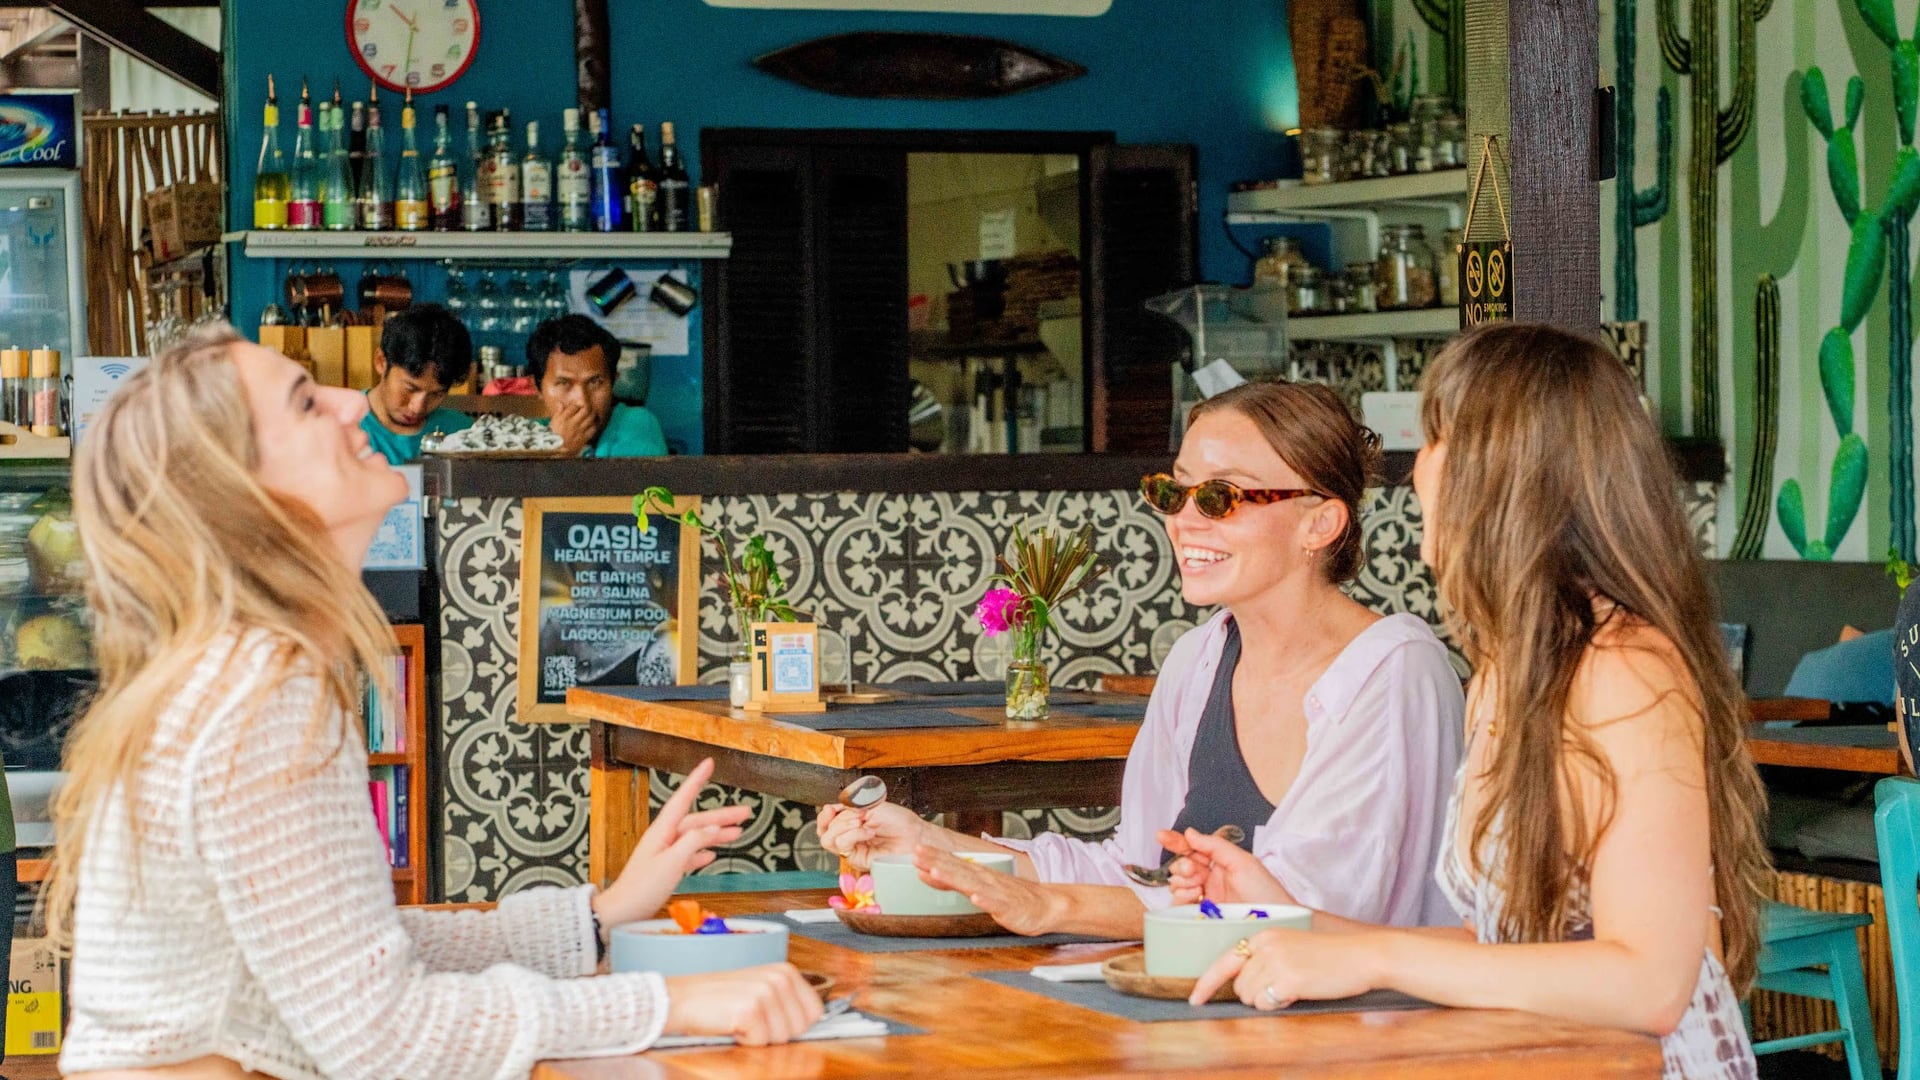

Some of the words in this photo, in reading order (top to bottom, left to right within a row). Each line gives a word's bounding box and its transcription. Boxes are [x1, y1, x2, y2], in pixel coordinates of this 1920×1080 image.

[363, 42, 377, 57] 8
[381, 64, 397, 79] 7
[431, 63, 446, 78] 5
[20, 139, 66, 162] Cool
[1465, 303, 1482, 327] NO
[567, 524, 659, 550] OASIS
[554, 548, 611, 563] HEALTH
[613, 550, 671, 564] TEMPLE
[575, 570, 598, 583] ICE
[600, 570, 647, 584] BATHS
[570, 586, 599, 598] DRY
[601, 586, 651, 600] SAUNA
[546, 607, 632, 621] MAGNESIUM
[634, 608, 672, 622] POOL
[560, 628, 618, 641] LAGOON
[620, 628, 657, 642] POOL
[757, 652, 768, 691] 1
